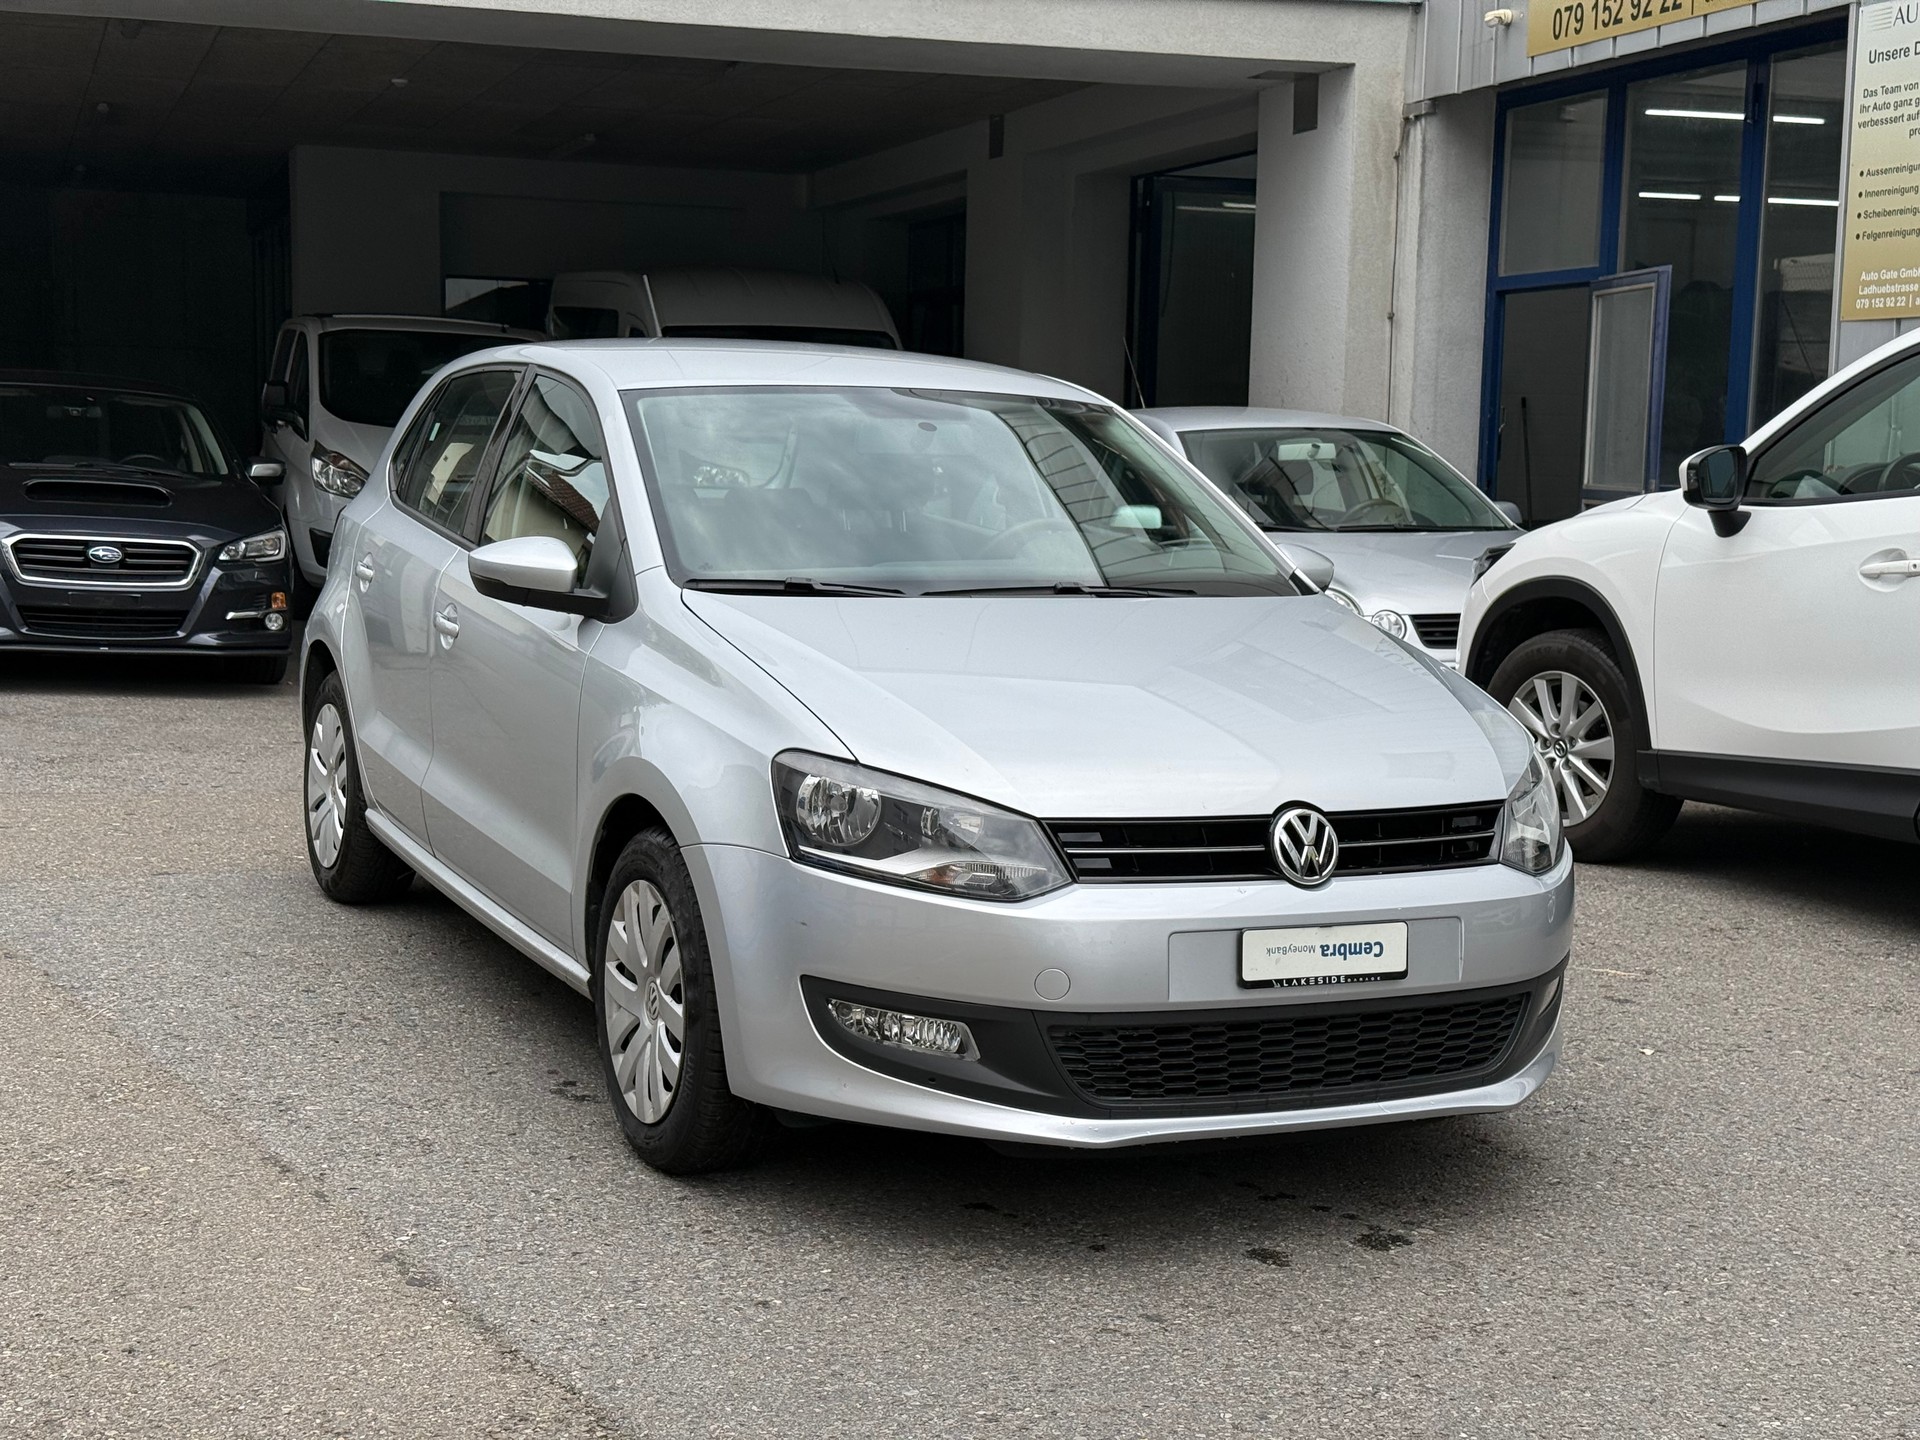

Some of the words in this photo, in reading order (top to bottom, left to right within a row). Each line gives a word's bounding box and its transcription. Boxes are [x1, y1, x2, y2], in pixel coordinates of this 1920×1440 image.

[1553, 3, 1584, 40] 079
[1592, 0, 1623, 30] 152
[1893, 2, 1919, 27] AU
[1869, 46, 1910, 64] Unsere
[1863, 88, 1878, 99] Das
[1880, 85, 1902, 96] Team
[1904, 82, 1919, 92] von
[1859, 103, 1871, 114] Ihr
[1872, 101, 1891, 112] Auto
[1893, 98, 1913, 111] ganz
[1864, 185, 1919, 198] Innenreinigung
[1862, 227, 1920, 241] Felgenreinigung
[1860, 270, 1879, 282] Auto
[1880, 269, 1898, 280] Gate
[1858, 283, 1919, 295] Ladhuebstrasse
[1855, 298, 1869, 309] 079
[1871, 297, 1884, 308] 152
[1886, 296, 1895, 307] 92
[1896, 296, 1906, 307] 22
[1266, 943, 1316, 957] MoneyBank
[1319, 941, 1384, 961] Cembra
[1283, 975, 1346, 987] LAKESIDE
